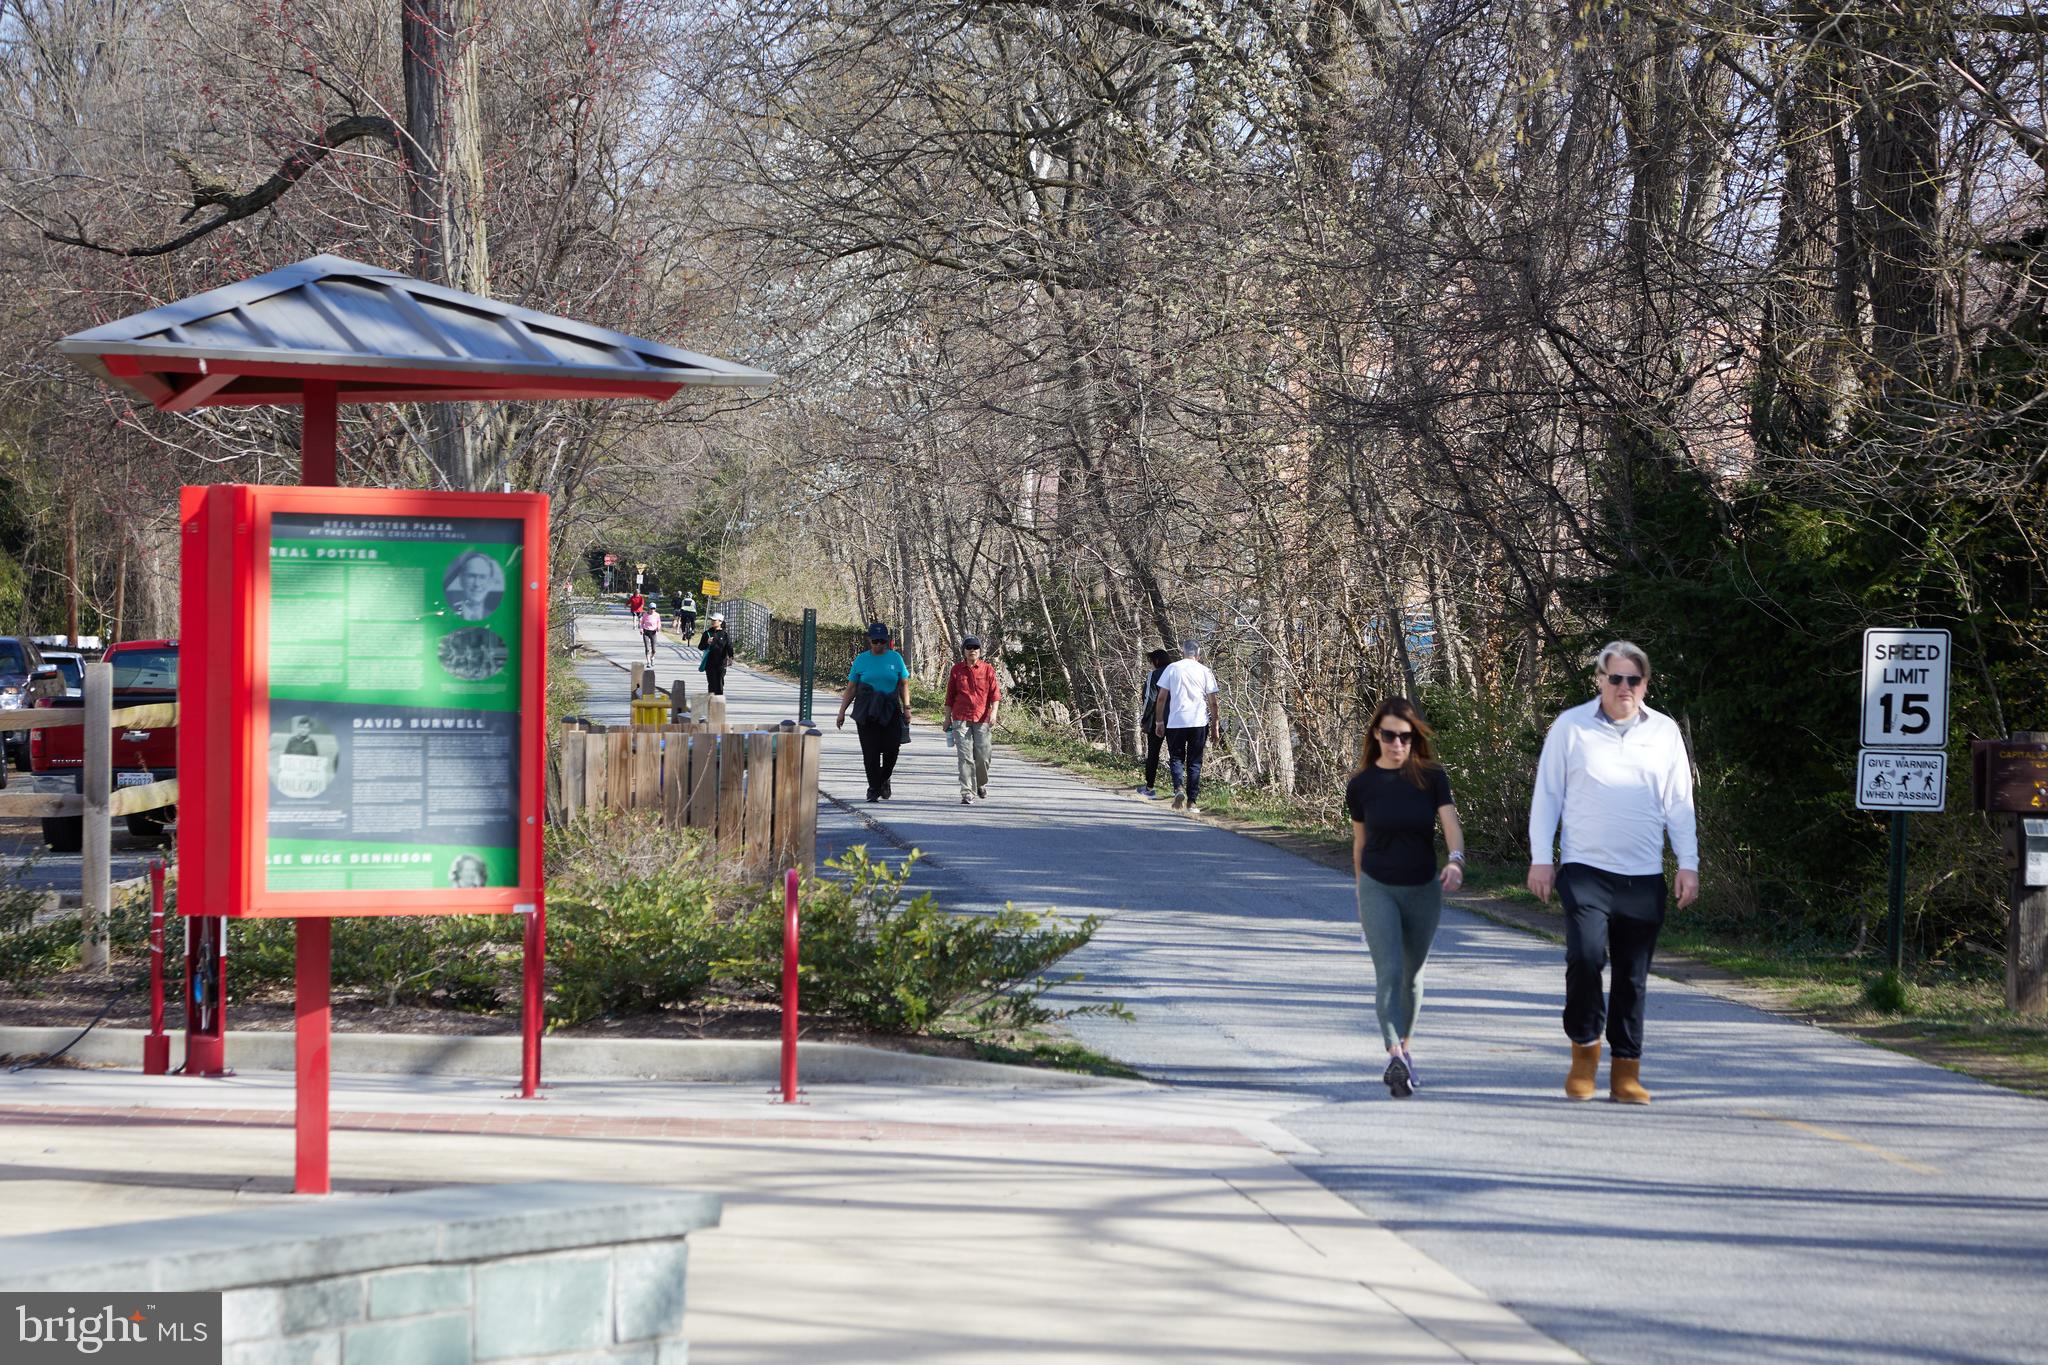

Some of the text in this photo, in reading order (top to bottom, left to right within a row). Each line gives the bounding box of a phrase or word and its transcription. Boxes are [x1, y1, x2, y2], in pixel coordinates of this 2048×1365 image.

[323, 521, 452, 531] NEAL POTTER PLAZA
[346, 529, 385, 537] CAPITAL
[388, 530, 436, 538] CRESCENT
[439, 531, 467, 539] TRAIL
[269, 546, 378, 559] NEAL POTTER
[1874, 643, 1940, 660] SPEED
[1883, 668, 1929, 684] LIMIT
[1879, 693, 1931, 734] 15
[352, 718, 485, 729] DAVID BURWELL
[1868, 759, 1938, 769] GIVE WARNING
[1866, 790, 1937, 800] WHEN PASSING
[301, 853, 342, 864] WICK
[350, 853, 432, 864] DENNISON
